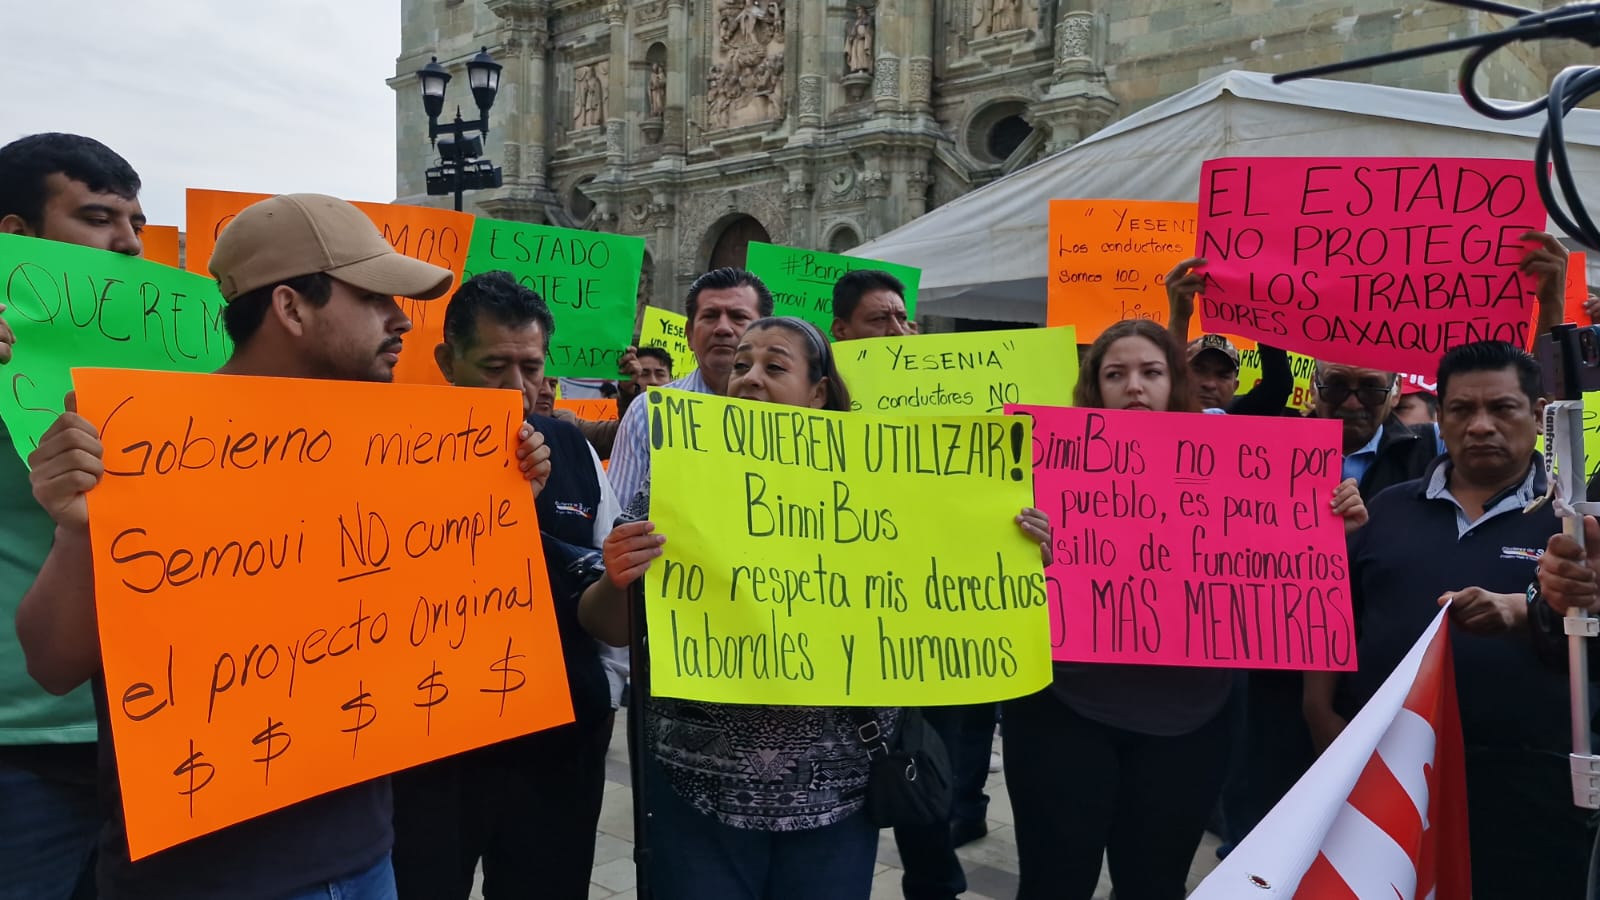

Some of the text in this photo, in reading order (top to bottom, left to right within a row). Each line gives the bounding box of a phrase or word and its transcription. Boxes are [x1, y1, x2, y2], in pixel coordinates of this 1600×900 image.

[1208, 163, 1526, 218] EL ESTADO
[489, 228, 610, 270] ESTADO
[1059, 234, 1184, 257] Los conductores
[1202, 223, 1535, 267] NO PROTEGE
[7, 262, 228, 363] QUEREM
[1250, 270, 1319, 310] LOS
[1203, 298, 1528, 355] DORES OAXAQUEÑOS
[877, 383, 974, 411] conductores
[989, 382, 1020, 409] NO
[101, 396, 511, 476] Gobierno miente!
[723, 404, 847, 473] QUIEREN
[865, 421, 1026, 482] UTILIZAR!
[1176, 438, 1215, 478] no
[1238, 443, 1271, 481] es
[1290, 446, 1338, 498] por
[338, 502, 390, 568] NO
[405, 494, 518, 567] cumple
[1061, 480, 1167, 529] pueblo,
[1180, 490, 1210, 518] es
[1224, 495, 1279, 537] para
[1293, 487, 1320, 531] el
[1050, 524, 1346, 581] lsillo de funcionarios
[661, 552, 1048, 617] no respeta mis derechos
[1091, 575, 1161, 654] MÁS
[1184, 579, 1350, 669] MENTIRAS
[122, 645, 174, 721] el
[207, 600, 388, 723] proyecto
[670, 609, 1018, 696] laborales y humanos
